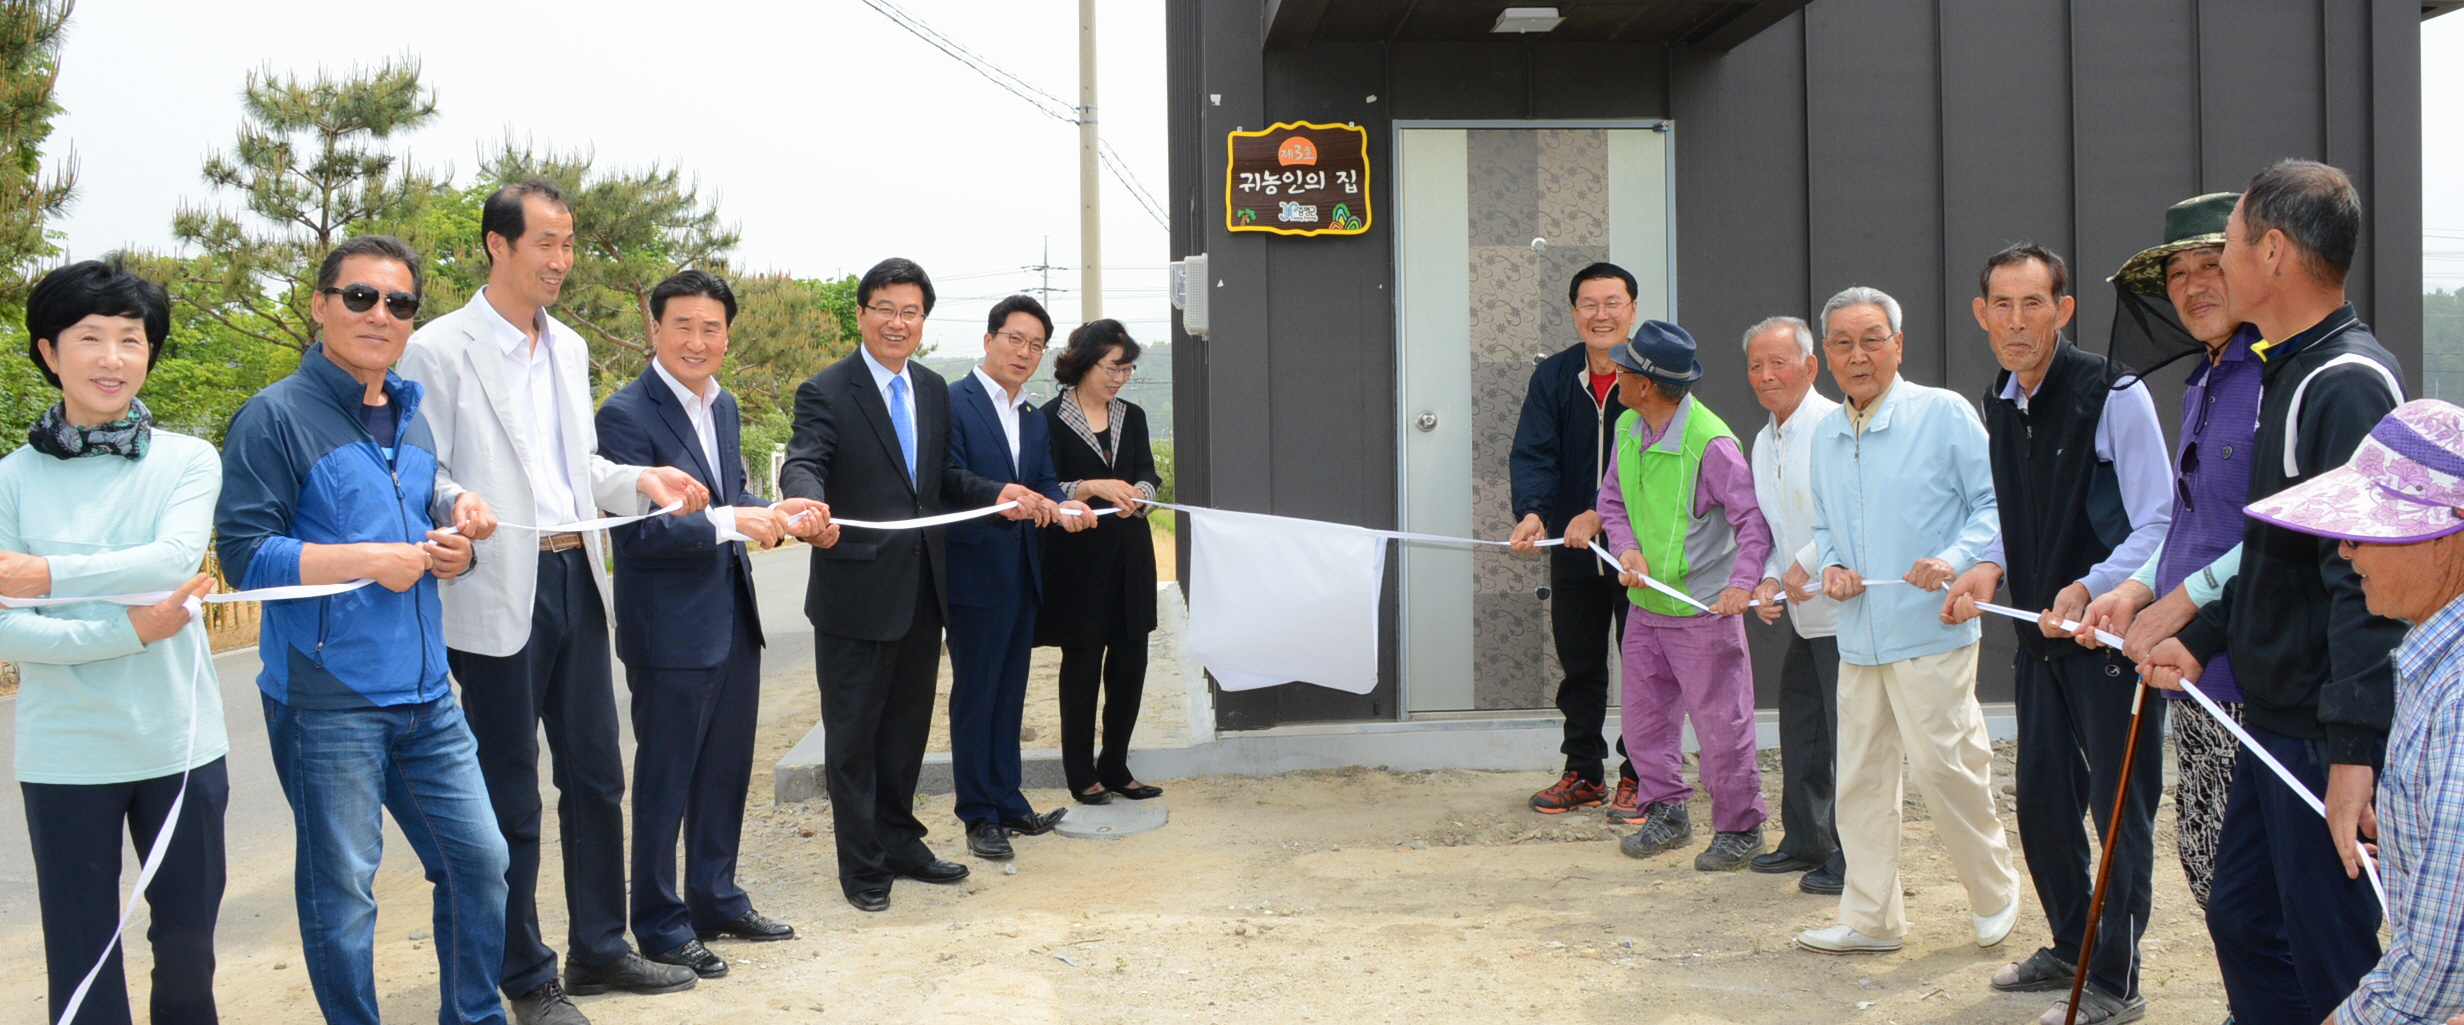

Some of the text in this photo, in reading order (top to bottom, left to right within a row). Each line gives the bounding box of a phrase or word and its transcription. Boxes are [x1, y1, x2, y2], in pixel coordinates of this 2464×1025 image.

[1281, 145, 1315, 160] 제3호
[1239, 169, 1358, 195] 귀농인의 집
